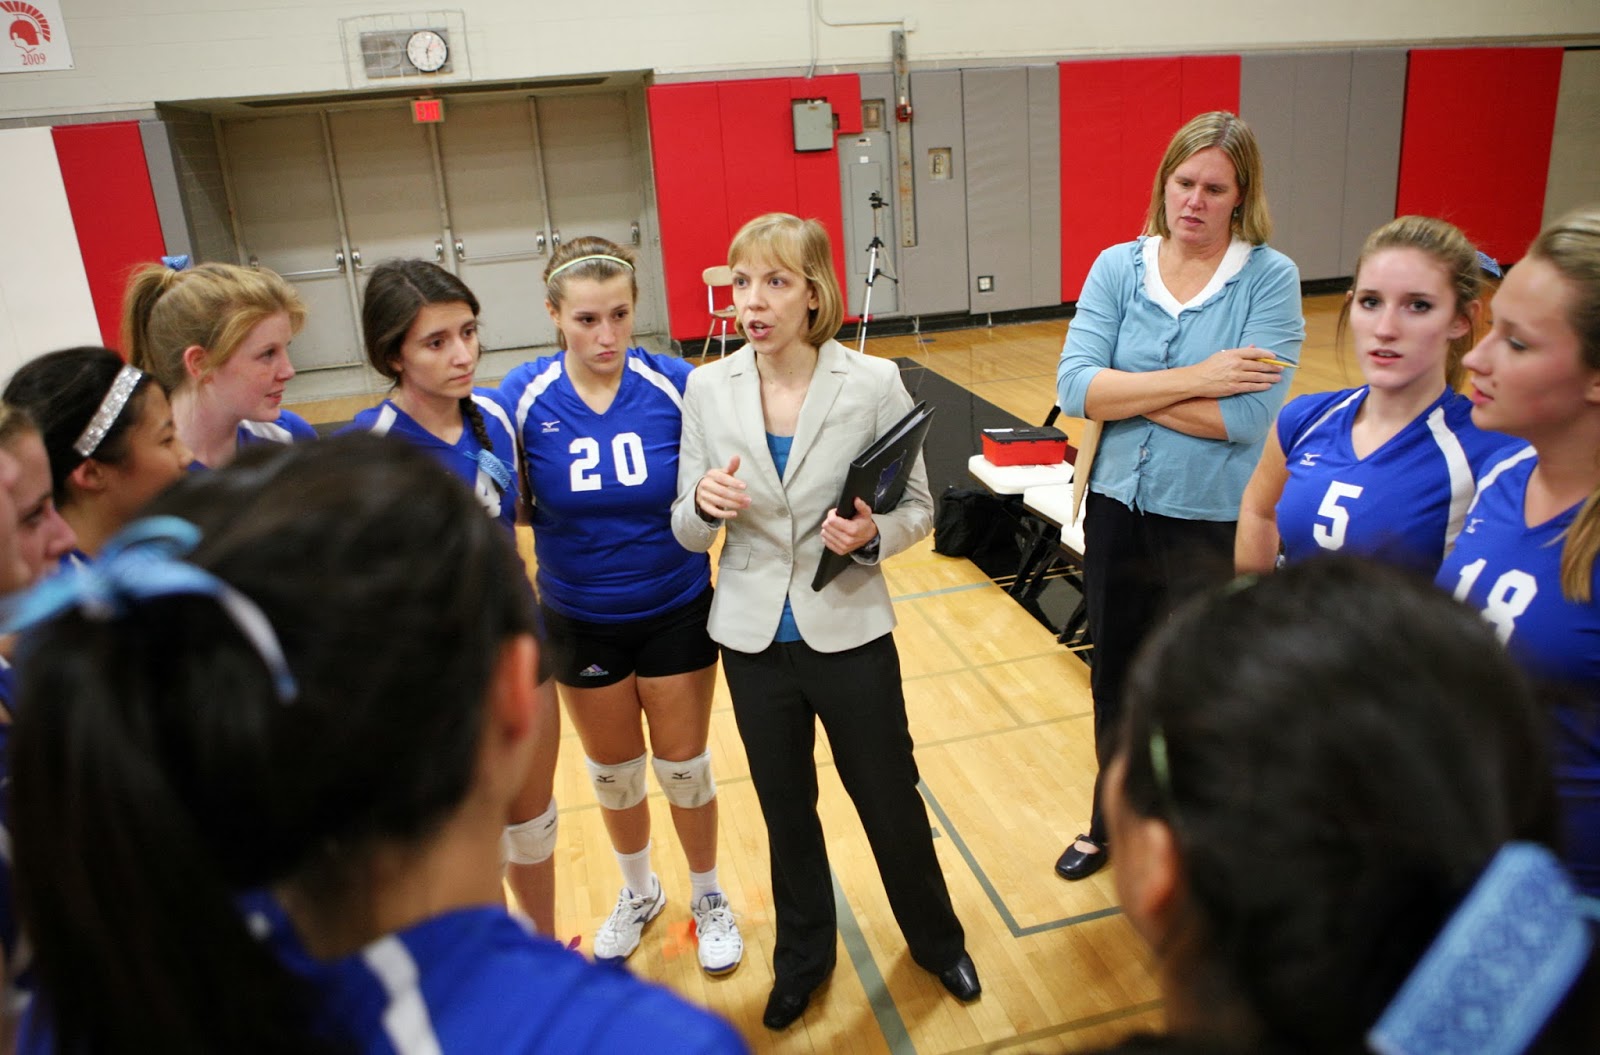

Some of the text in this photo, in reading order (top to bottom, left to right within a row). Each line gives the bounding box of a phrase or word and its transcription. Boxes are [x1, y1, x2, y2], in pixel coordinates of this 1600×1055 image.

[21, 53, 46, 66] 2009
[569, 432, 648, 492] 20
[1313, 480, 1364, 551] 5
[1452, 558, 1538, 646] 18
